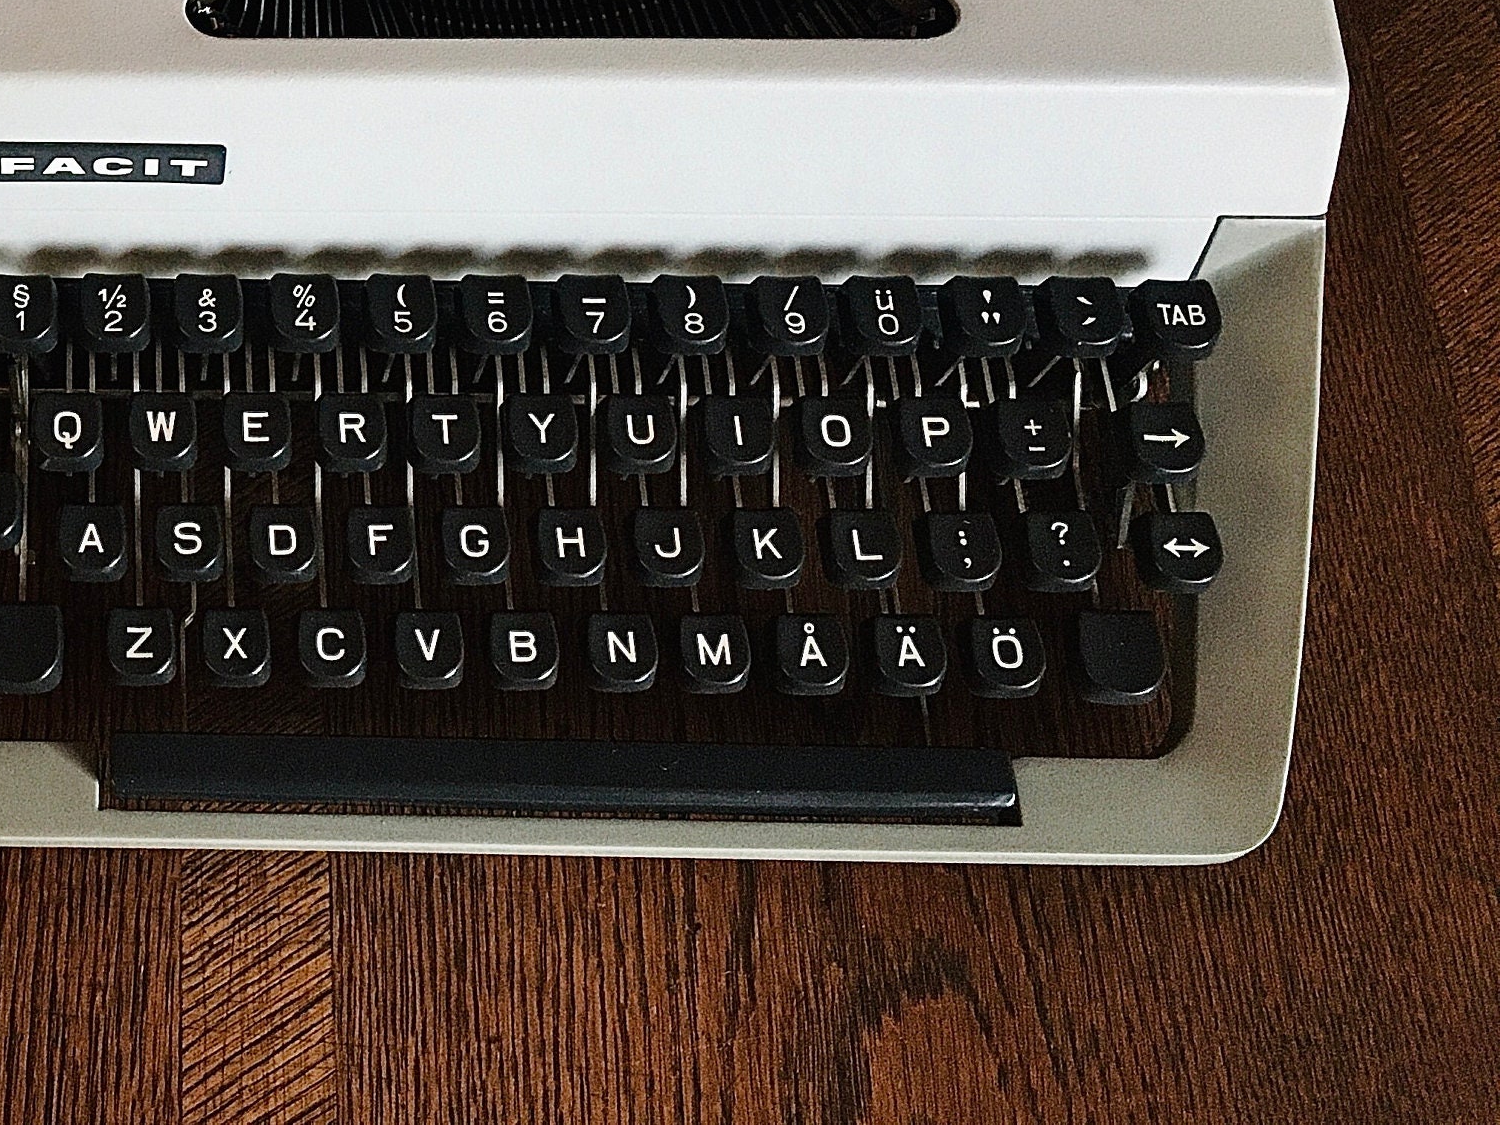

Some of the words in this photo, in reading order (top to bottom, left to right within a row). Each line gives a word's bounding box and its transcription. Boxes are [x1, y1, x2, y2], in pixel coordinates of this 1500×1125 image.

[0, 157, 208, 177] FACIT
[12, 283, 30, 309] §
[198, 288, 217, 308] &
[292, 283, 316, 309] %
[396, 283, 407, 308] (
[487, 291, 505, 304] =
[685, 285, 697, 309] )
[783, 285, 800, 311] /
[874, 289, 894, 311] ü
[15, 310, 25, 332] 1
[103, 310, 123, 332] 2
[198, 310, 217, 333] 3
[294, 308, 317, 331] 4
[394, 310, 413, 333] 5
[487, 311, 508, 333] 6
[585, 311, 605, 334] 7
[684, 312, 705, 334] 8
[784, 312, 806, 335] 9
[1156, 303, 1206, 326] TAB
[53, 411, 82, 450] Q
[146, 410, 177, 442] W
[242, 411, 270, 443] E
[338, 413, 367, 444] R
[431, 414, 458, 445] T
[527, 413, 555, 444] Y
[626, 414, 655, 445] U
[733, 415, 743, 446] I
[820, 414, 852, 448] O
[921, 416, 950, 448] P
[78, 523, 104, 553] A
[173, 522, 202, 555] S
[268, 524, 297, 556] D
[367, 524, 394, 556] F
[460, 524, 490, 558] G
[556, 527, 586, 558] H
[654, 527, 682, 558] J
[752, 528, 783, 560] K
[851, 529, 884, 561] L
[126, 626, 154, 659] Z
[222, 627, 248, 660] X
[316, 627, 345, 661] C
[414, 628, 441, 661] V
[509, 630, 537, 663] B
[607, 631, 637, 663] N
[696, 633, 732, 666] M
[800, 622, 828, 667] Å
[895, 626, 926, 667] Ä
[992, 627, 1024, 669] Ö
